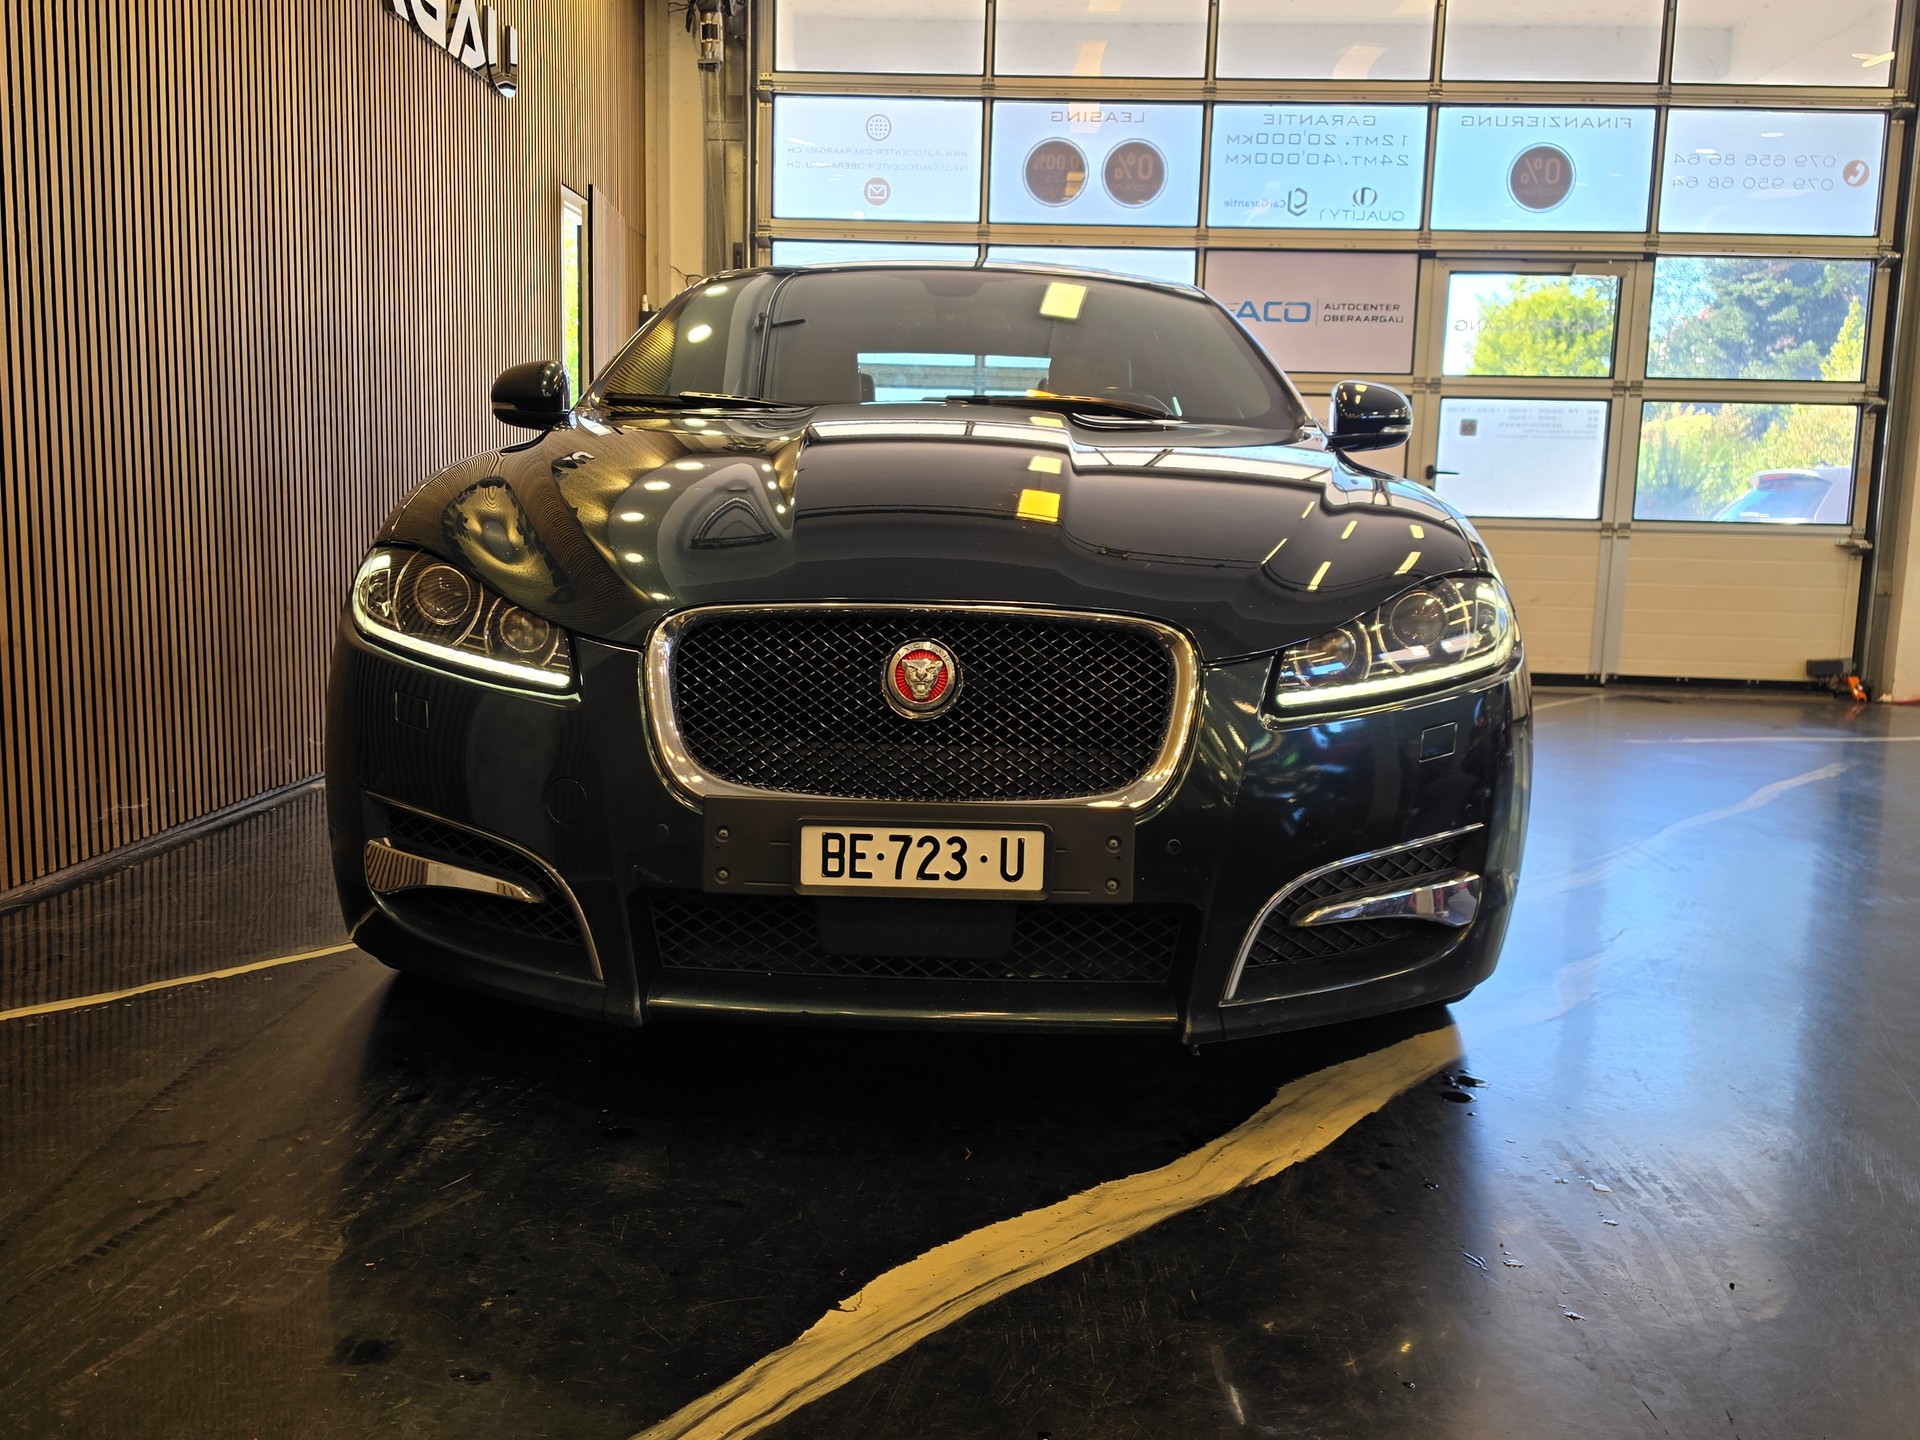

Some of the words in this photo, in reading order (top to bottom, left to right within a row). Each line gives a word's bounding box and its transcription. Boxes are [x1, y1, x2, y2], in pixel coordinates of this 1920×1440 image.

[1236, 300, 1312, 322] ACO
[1324, 303, 1400, 312] AUTOCENTER
[1323, 314, 1404, 323] OBERAARGAU
